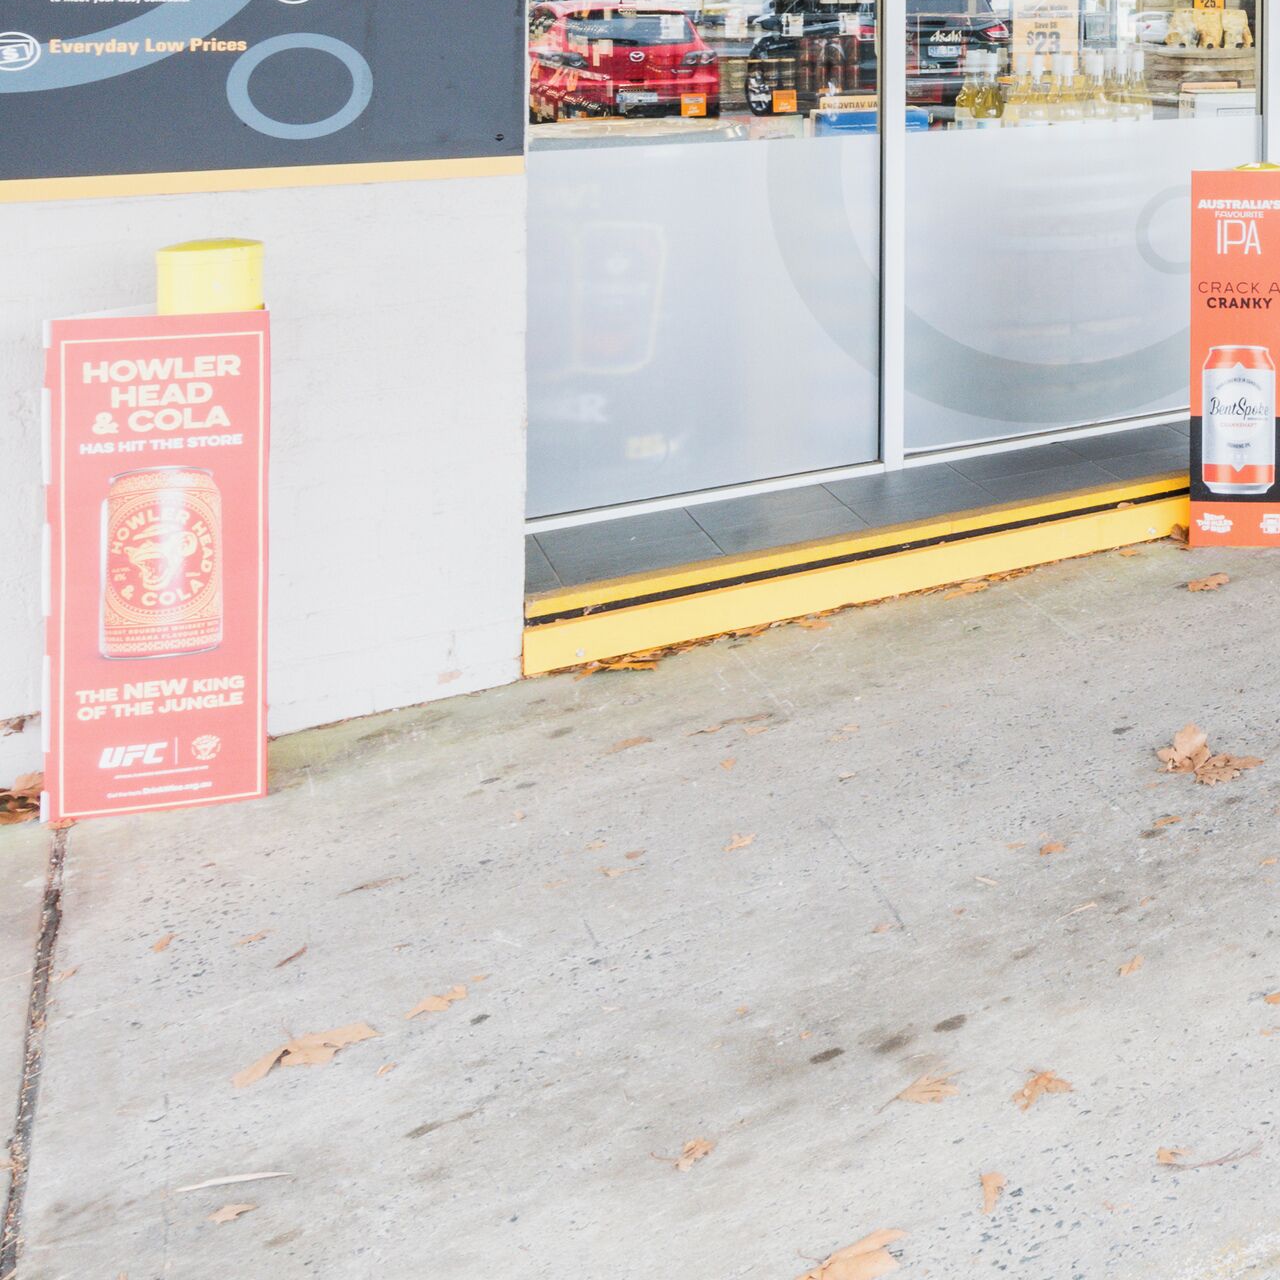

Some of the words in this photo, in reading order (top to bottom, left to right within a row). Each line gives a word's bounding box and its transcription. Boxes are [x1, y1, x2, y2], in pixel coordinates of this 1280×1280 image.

[47, 39, 139, 56] Everyday
[145, 38, 185, 53] Low
[189, 37, 247, 51] Prices
[929, 30, 962, 42] Asahi
[1214, 210, 1265, 219] FAVOURITE
[1216, 219, 1262, 255] IPA
[1197, 280, 1260, 295] CRACK
[1268, 281, 1280, 295] A
[1206, 297, 1273, 310] CRANKY
[83, 354, 241, 384] HOWLER
[111, 382, 213, 408] HEAD
[92, 412, 119, 434] &
[128, 405, 231, 432] COLA
[79, 442, 116, 454] HAS
[117, 440, 147, 452] HIT
[149, 437, 184, 450] THE
[186, 433, 243, 448] STORE
[111, 506, 190, 554] HOWLER
[192, 520, 214, 574] HEAD
[141, 579, 204, 607] COLA
[76, 688, 118, 704] THE
[123, 678, 188, 700] NEW
[192, 675, 245, 693] KING
[77, 705, 107, 721] OF
[111, 701, 154, 718] THE
[158, 691, 244, 713] JUNGLE
[98, 742, 168, 769] UFC
